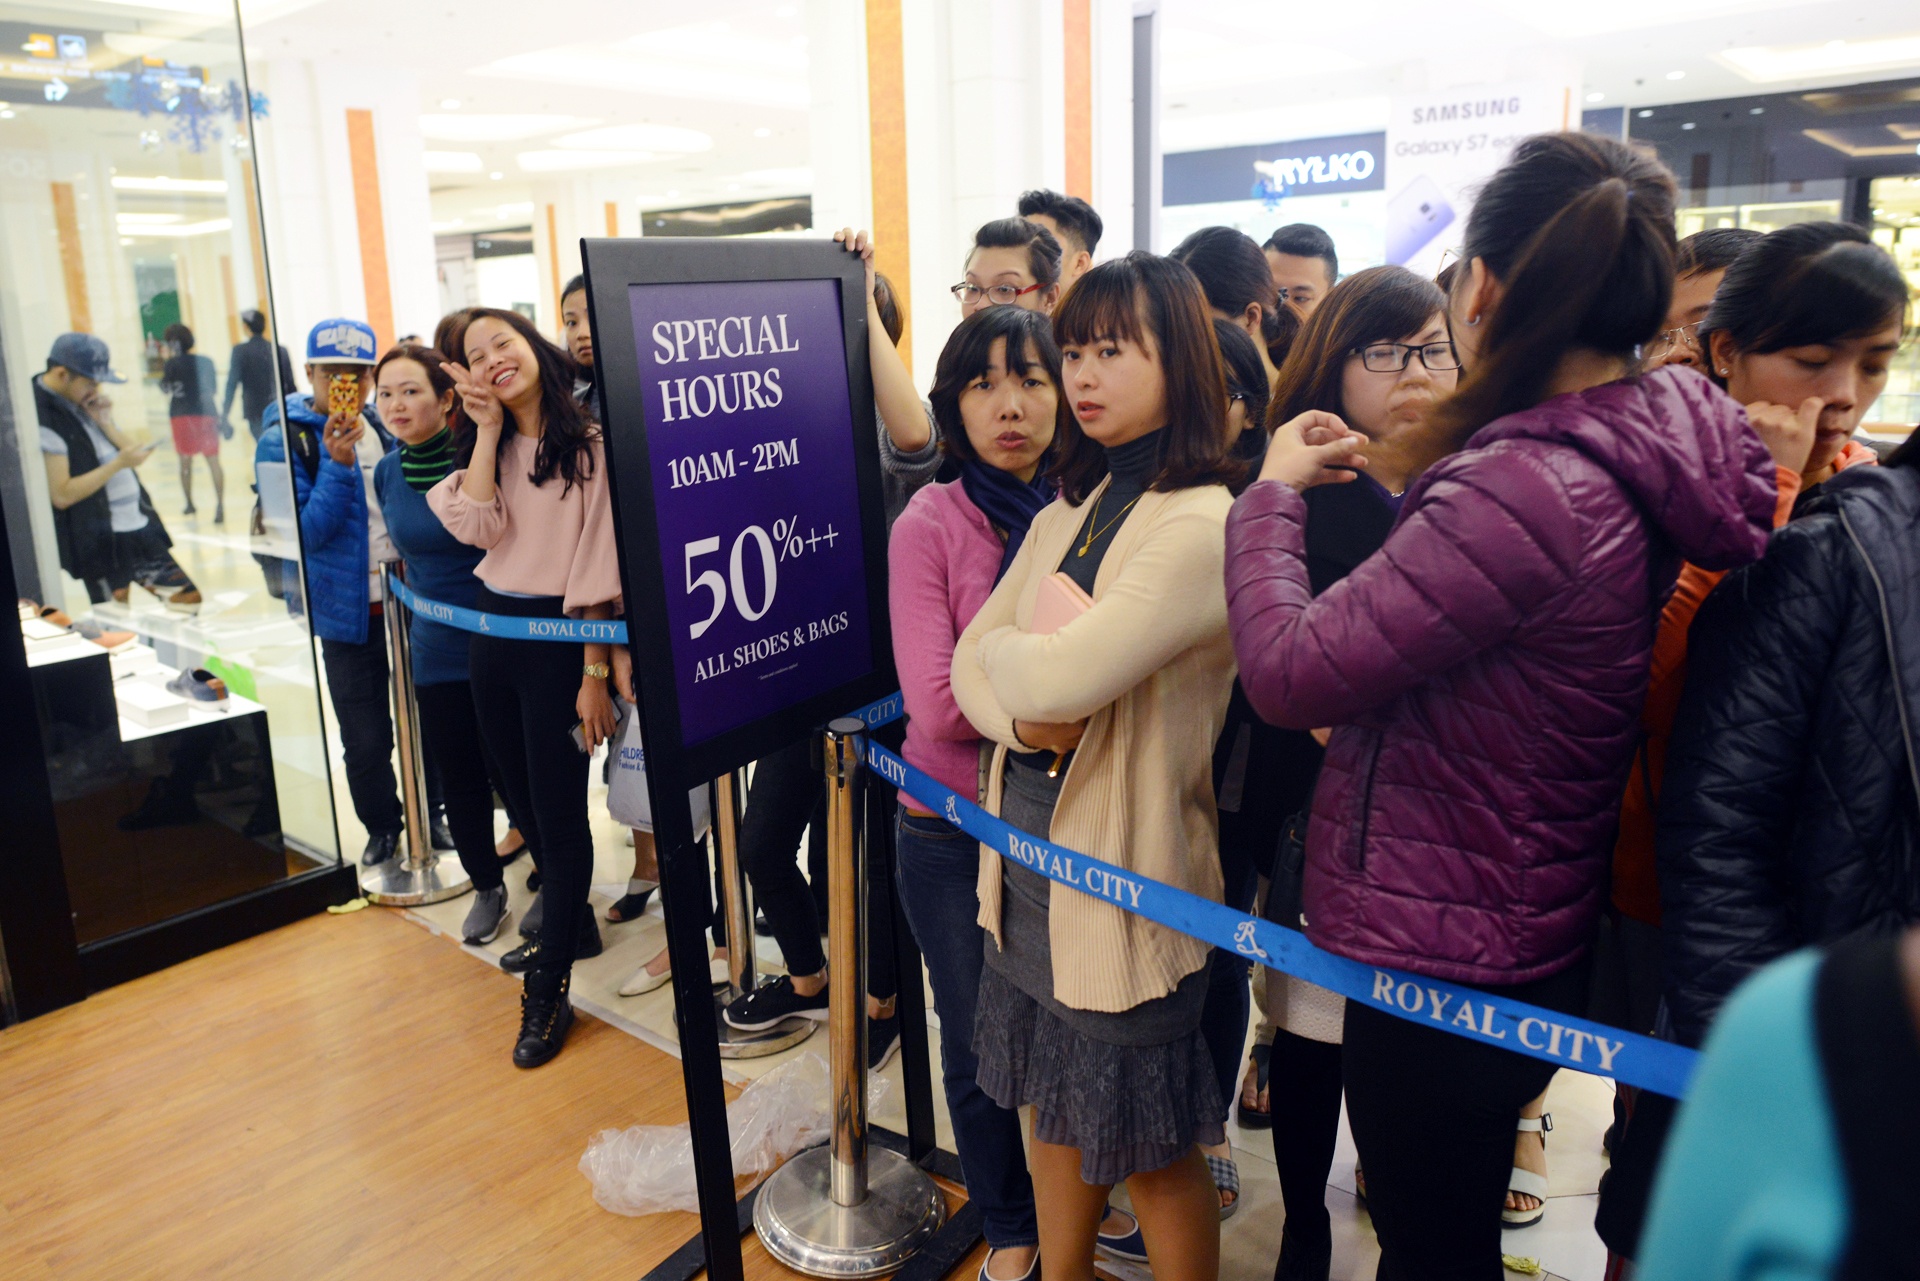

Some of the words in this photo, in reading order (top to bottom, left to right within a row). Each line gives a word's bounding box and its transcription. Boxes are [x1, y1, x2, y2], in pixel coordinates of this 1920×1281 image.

[1413, 97, 1520, 124] SAMSUNG
[1394, 139, 1462, 157] Galaxy
[1467, 133, 1488, 151] S7
[652, 314, 800, 365] SPECIAL
[658, 368, 783, 423] HOURS
[667, 449, 737, 489] 10AM
[752, 438, 800, 472] 2PM
[433, 604, 454, 621] CITY
[528, 621, 577, 637] ROYAL
[580, 623, 618, 639] CITY
[694, 653, 731, 683] ALL
[733, 631, 790, 668] SHOES
[793, 626, 805, 647] &
[808, 611, 849, 642] BAGS
[868, 697, 899, 724] CITY
[880, 754, 907, 786] CITY
[1008, 833, 1080, 884] ROYAL
[1085, 867, 1144, 908] CITY
[1371, 970, 1506, 1039] ROYAL
[1517, 1017, 1625, 1071] CITY
